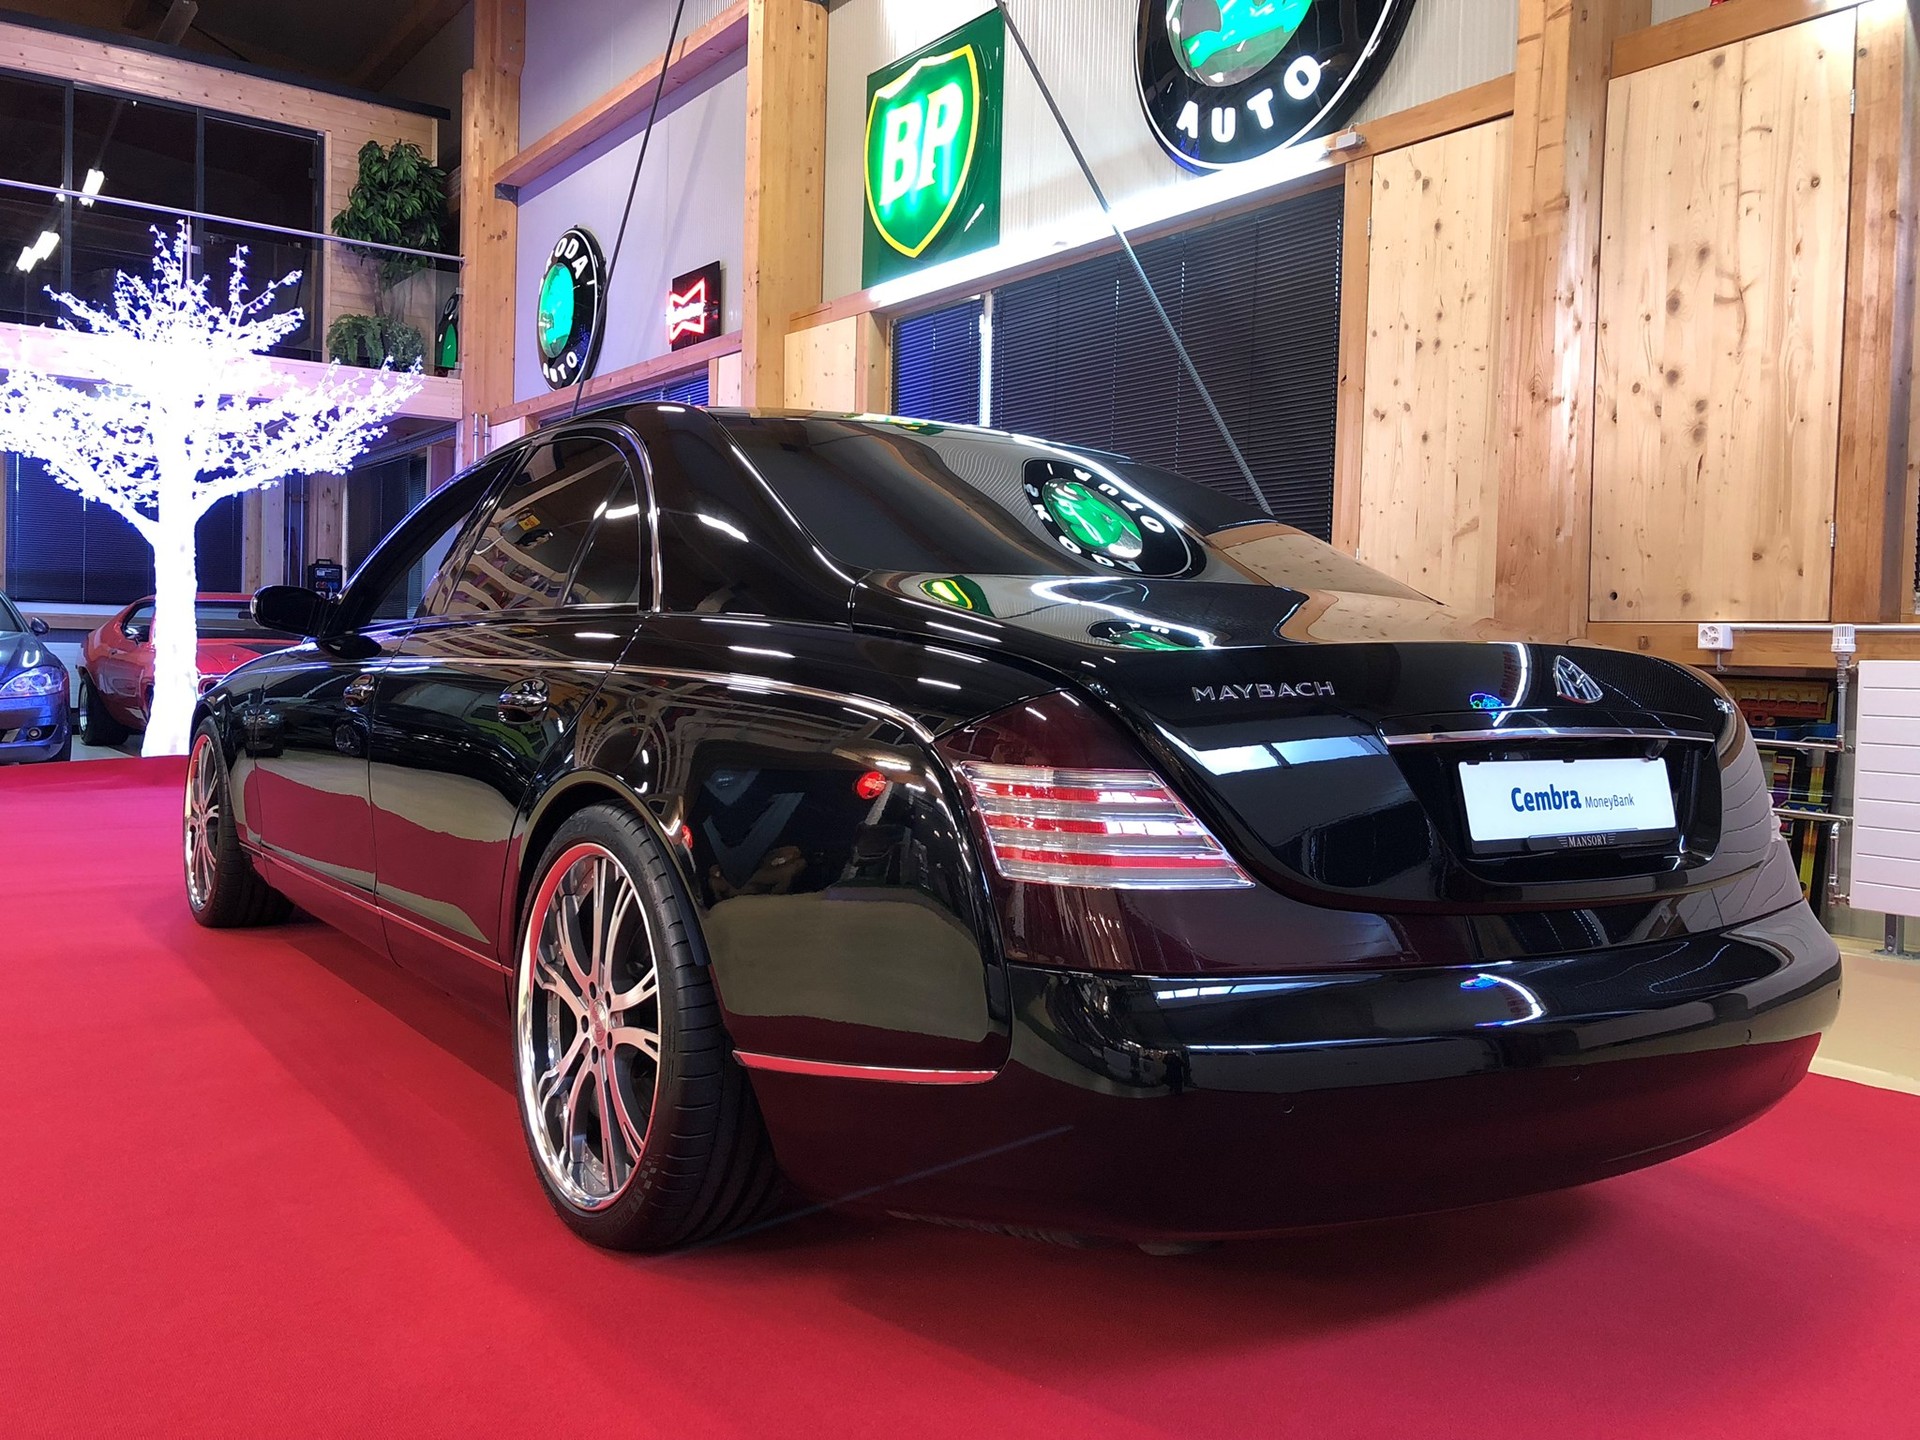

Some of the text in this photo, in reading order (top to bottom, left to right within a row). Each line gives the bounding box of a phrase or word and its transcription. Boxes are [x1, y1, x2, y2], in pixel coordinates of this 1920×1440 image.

[1176, 55, 1321, 143] AUTO
[878, 82, 964, 206] BP
[542, 351, 578, 382] AUTO
[1191, 681, 1336, 702] MAYBACH
[1510, 783, 1635, 812] Cembra MoneyBank
[1567, 833, 1608, 848] MANSORY
